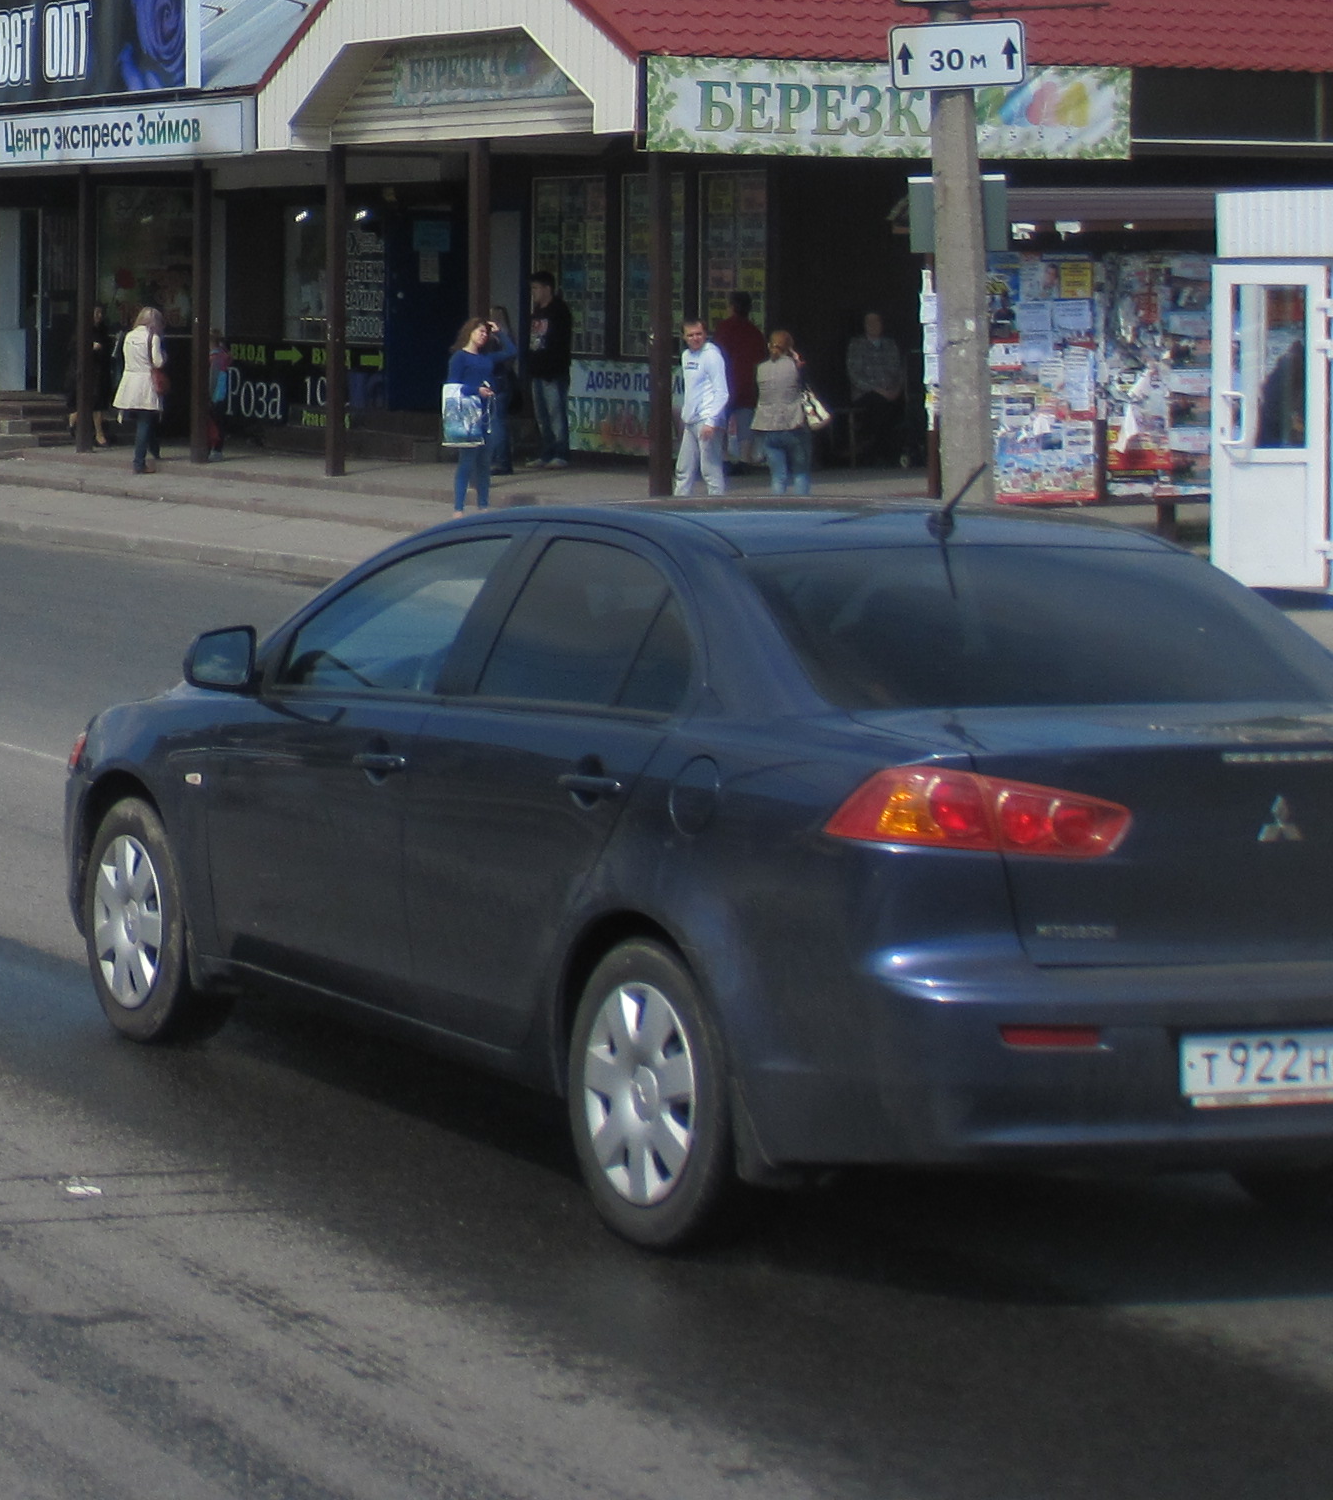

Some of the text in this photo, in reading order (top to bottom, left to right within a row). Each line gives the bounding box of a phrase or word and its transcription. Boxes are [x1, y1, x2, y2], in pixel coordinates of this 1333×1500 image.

[929, 49, 964, 72] 30
[695, 79, 932, 138] БЕРЕЗК
[4, 112, 201, 159] Центр экспресс Займов
[226, 367, 283, 420] Роза
[586, 370, 631, 392] ДОБРО
